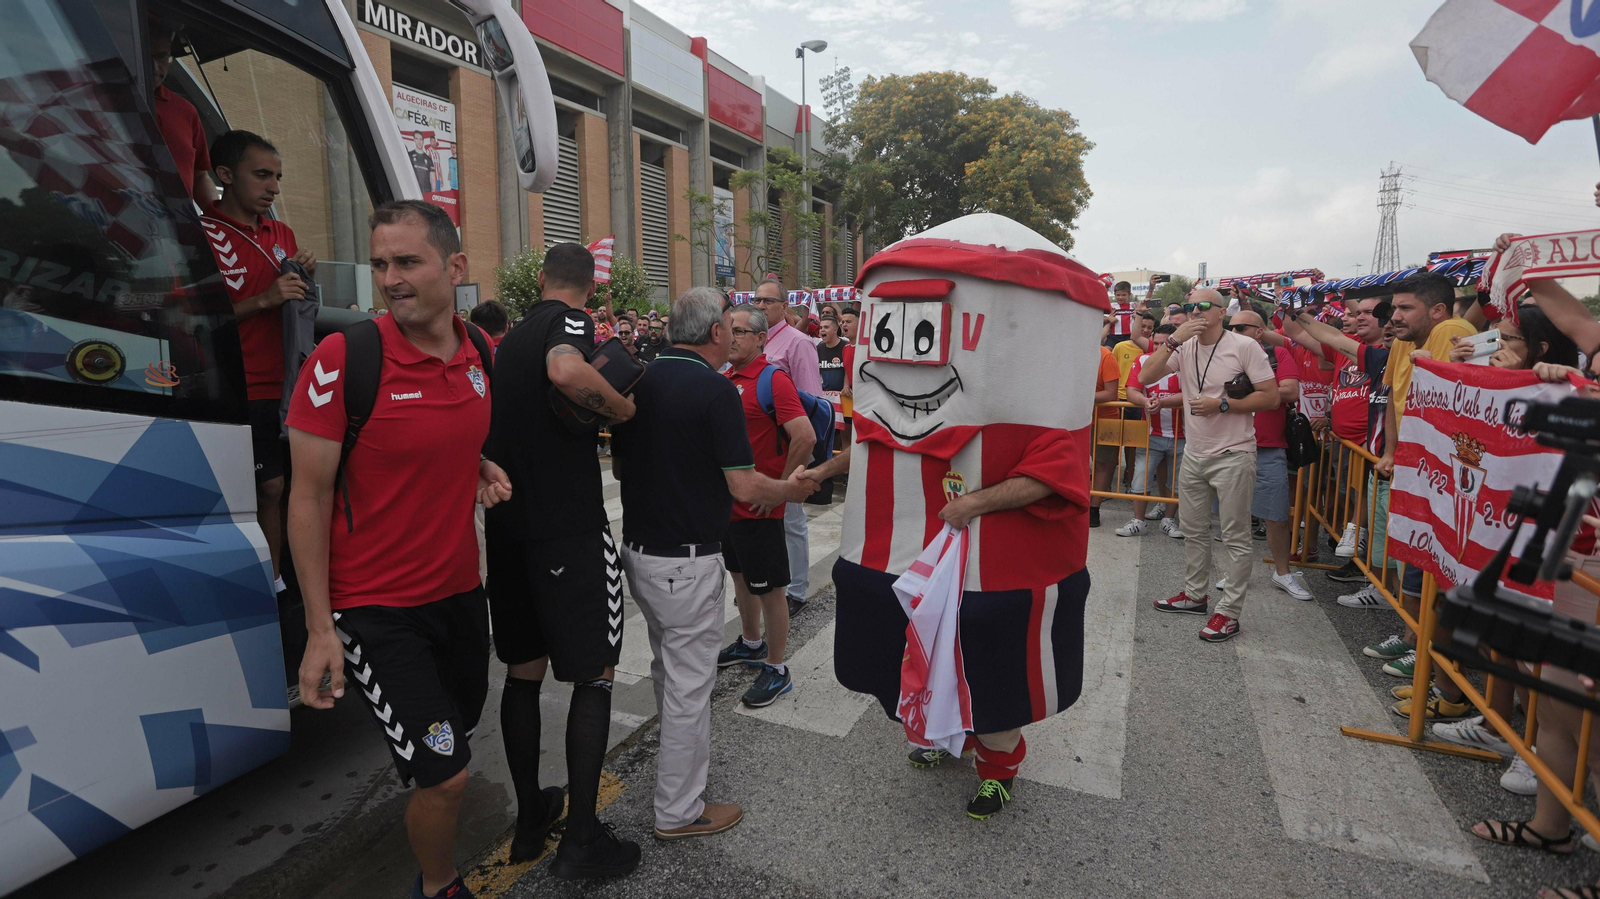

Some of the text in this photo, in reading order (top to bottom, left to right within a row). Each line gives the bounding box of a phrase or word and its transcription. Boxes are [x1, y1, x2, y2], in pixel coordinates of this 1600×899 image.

[364, 0, 478, 65] MIRADOR
[396, 91, 437, 110] ALGECIRAS
[438, 104, 448, 113] CF
[394, 106, 452, 134] CAFÉ&ARTE
[962, 312, 985, 351] V
[391, 390, 423, 400] hummel
[1453, 380, 1481, 417] Club
[1484, 396, 1499, 428] de
